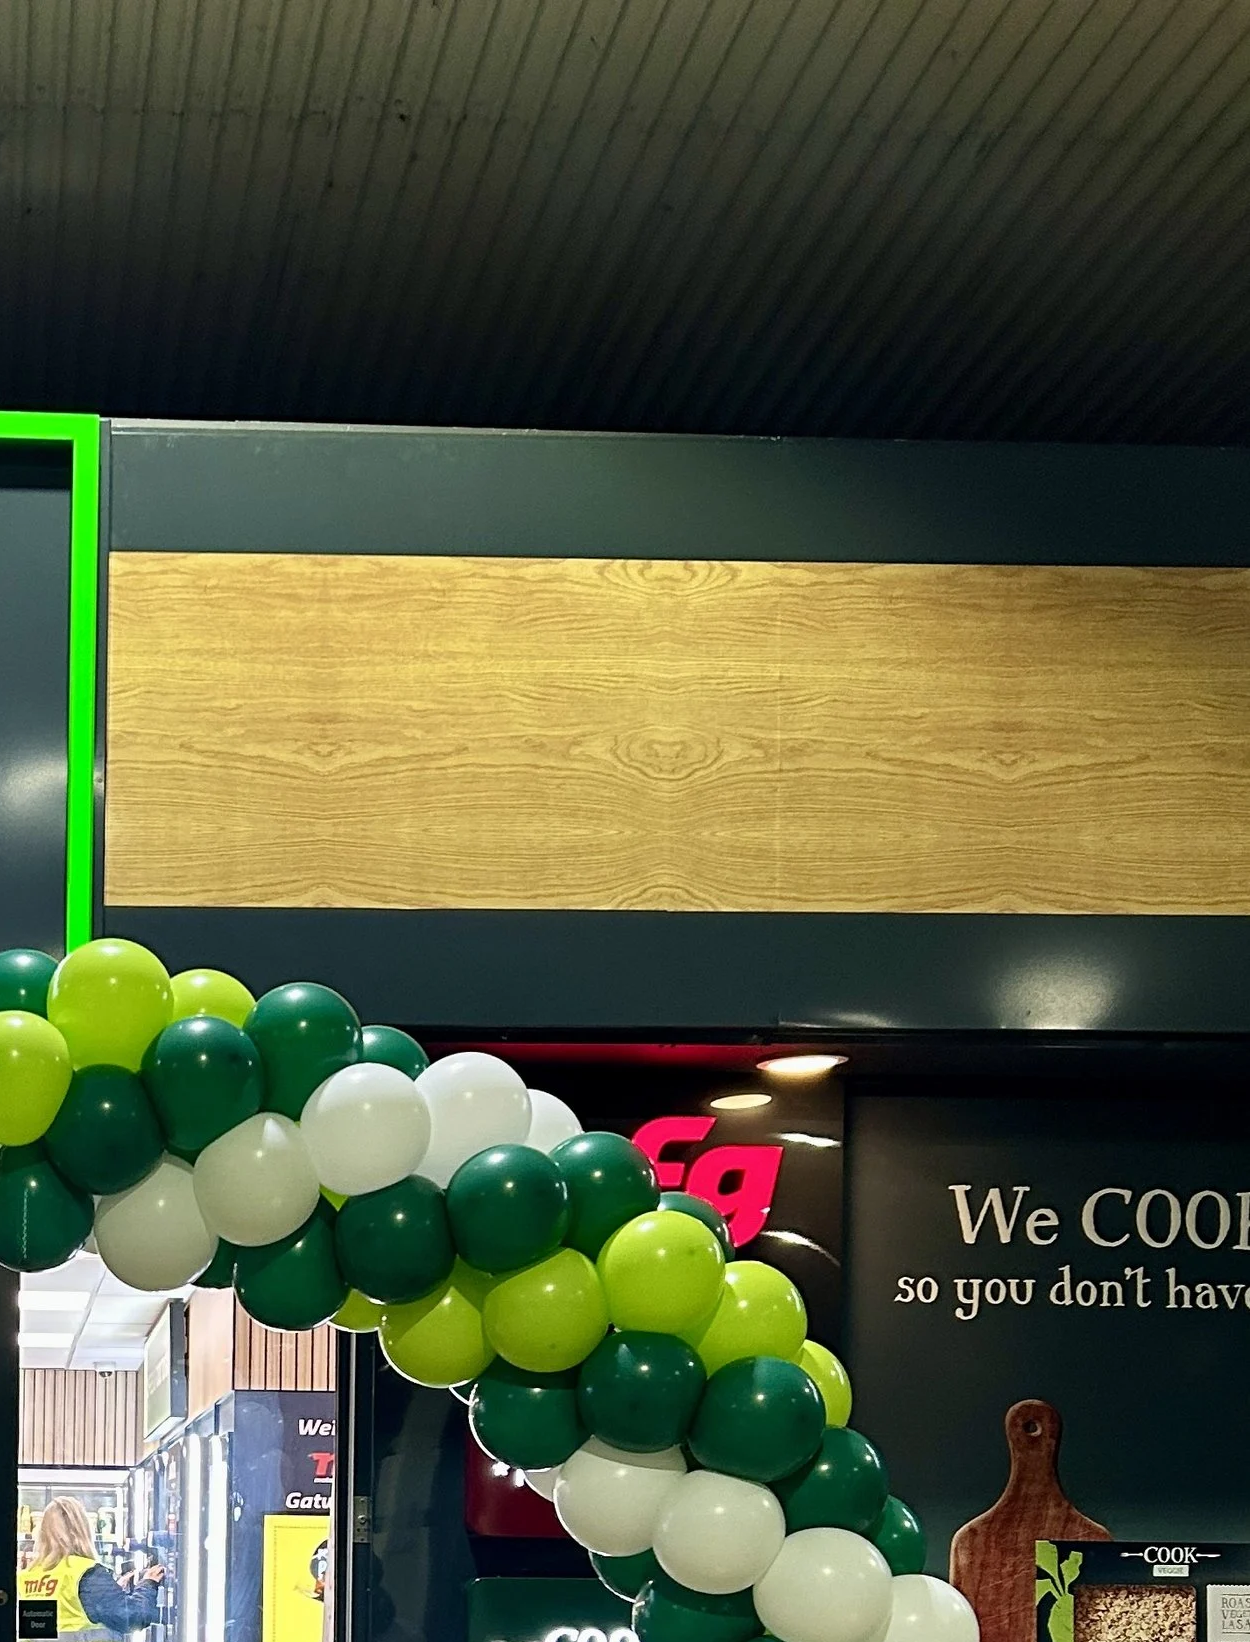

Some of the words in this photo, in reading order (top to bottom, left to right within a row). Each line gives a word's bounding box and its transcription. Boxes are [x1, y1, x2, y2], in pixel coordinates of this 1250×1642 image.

[948, 1184, 1060, 1246] We
[894, 1276, 939, 1303] so
[953, 1278, 1037, 1320] you
[1049, 1264, 1152, 1308] don't
[1143, 1546, 1198, 1563] COOK
[24, 1575, 58, 1596] mfg
[30, 1621, 46, 1629] Door
